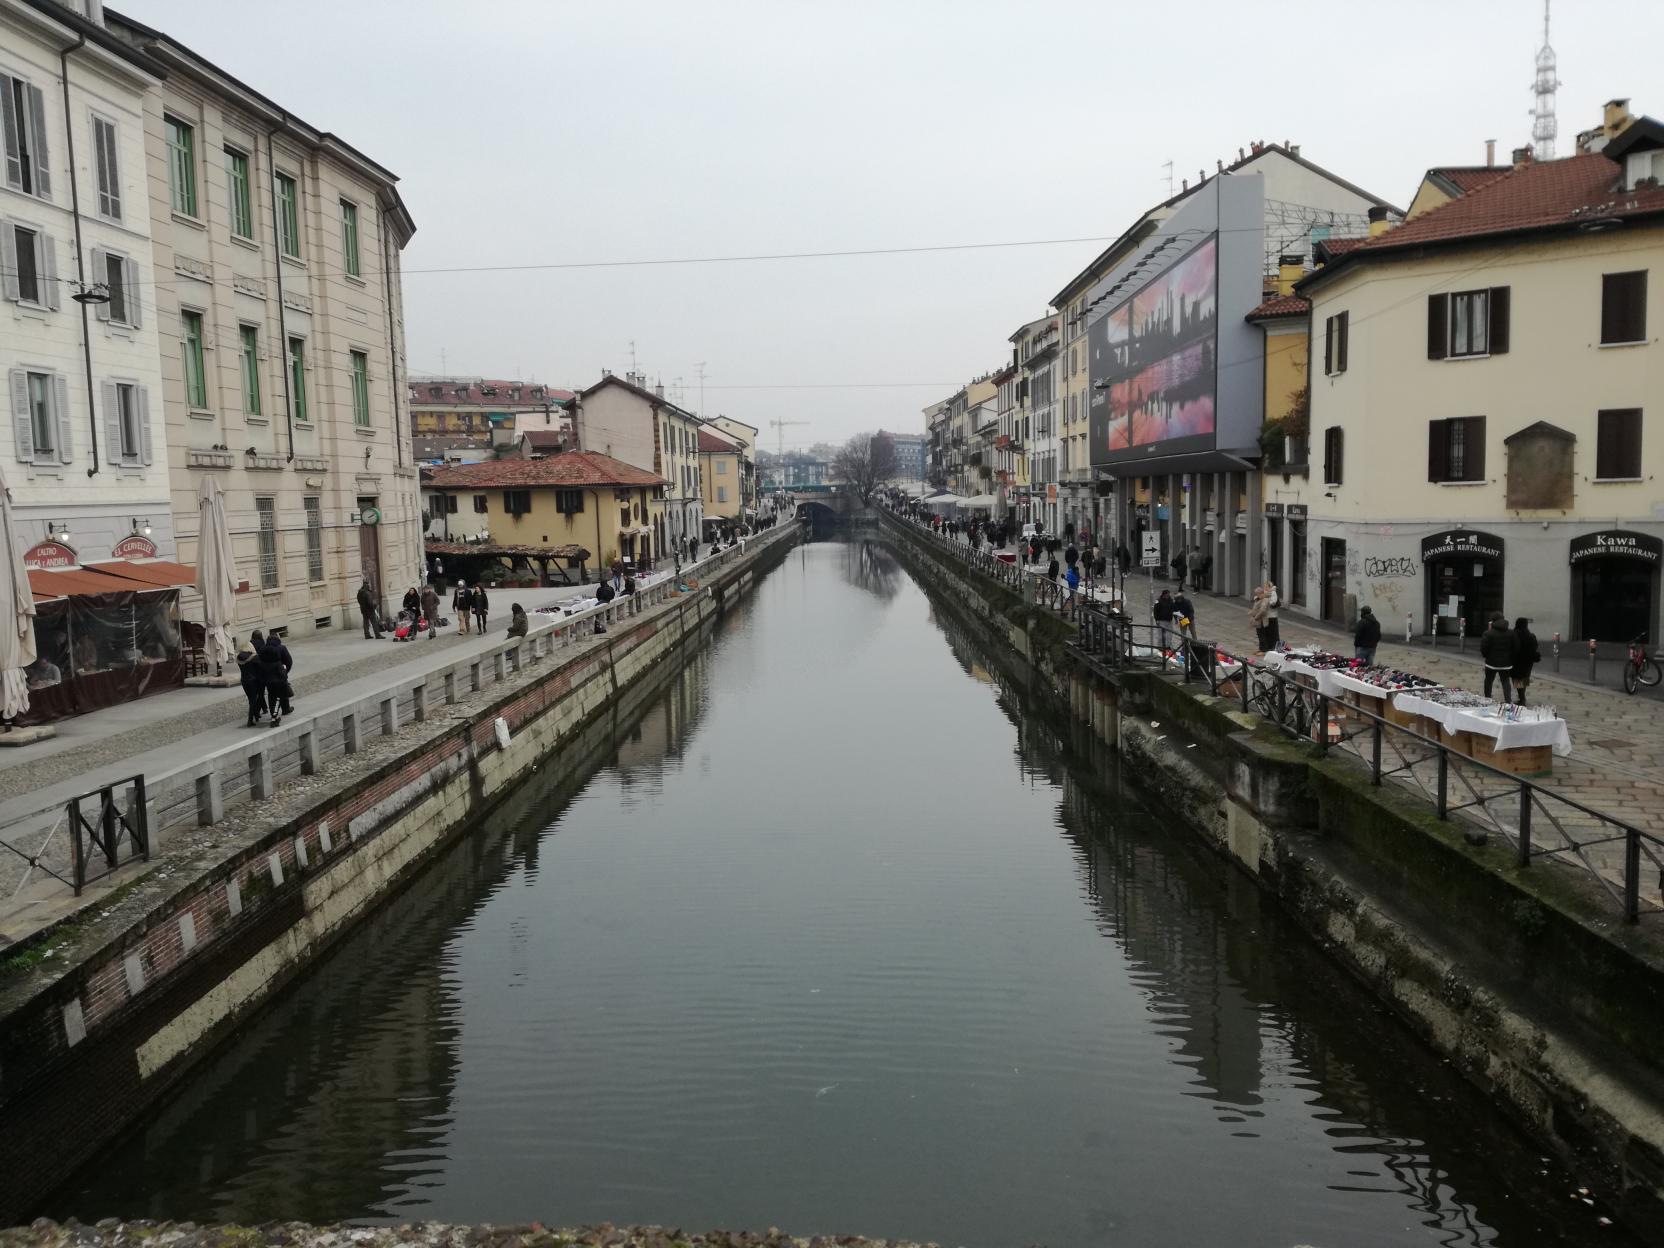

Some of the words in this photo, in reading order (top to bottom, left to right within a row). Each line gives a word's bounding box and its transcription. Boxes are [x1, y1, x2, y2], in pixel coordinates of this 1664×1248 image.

[1596, 535, 1637, 546] Kawa
[1424, 545, 1455, 558] JAPANESE
[1457, 544, 1500, 557] RESTAURANT
[1572, 546, 1607, 559] JAPANESE
[1609, 546, 1659, 560] RESTAURANT
[47, 557, 68, 567] ANDREA
